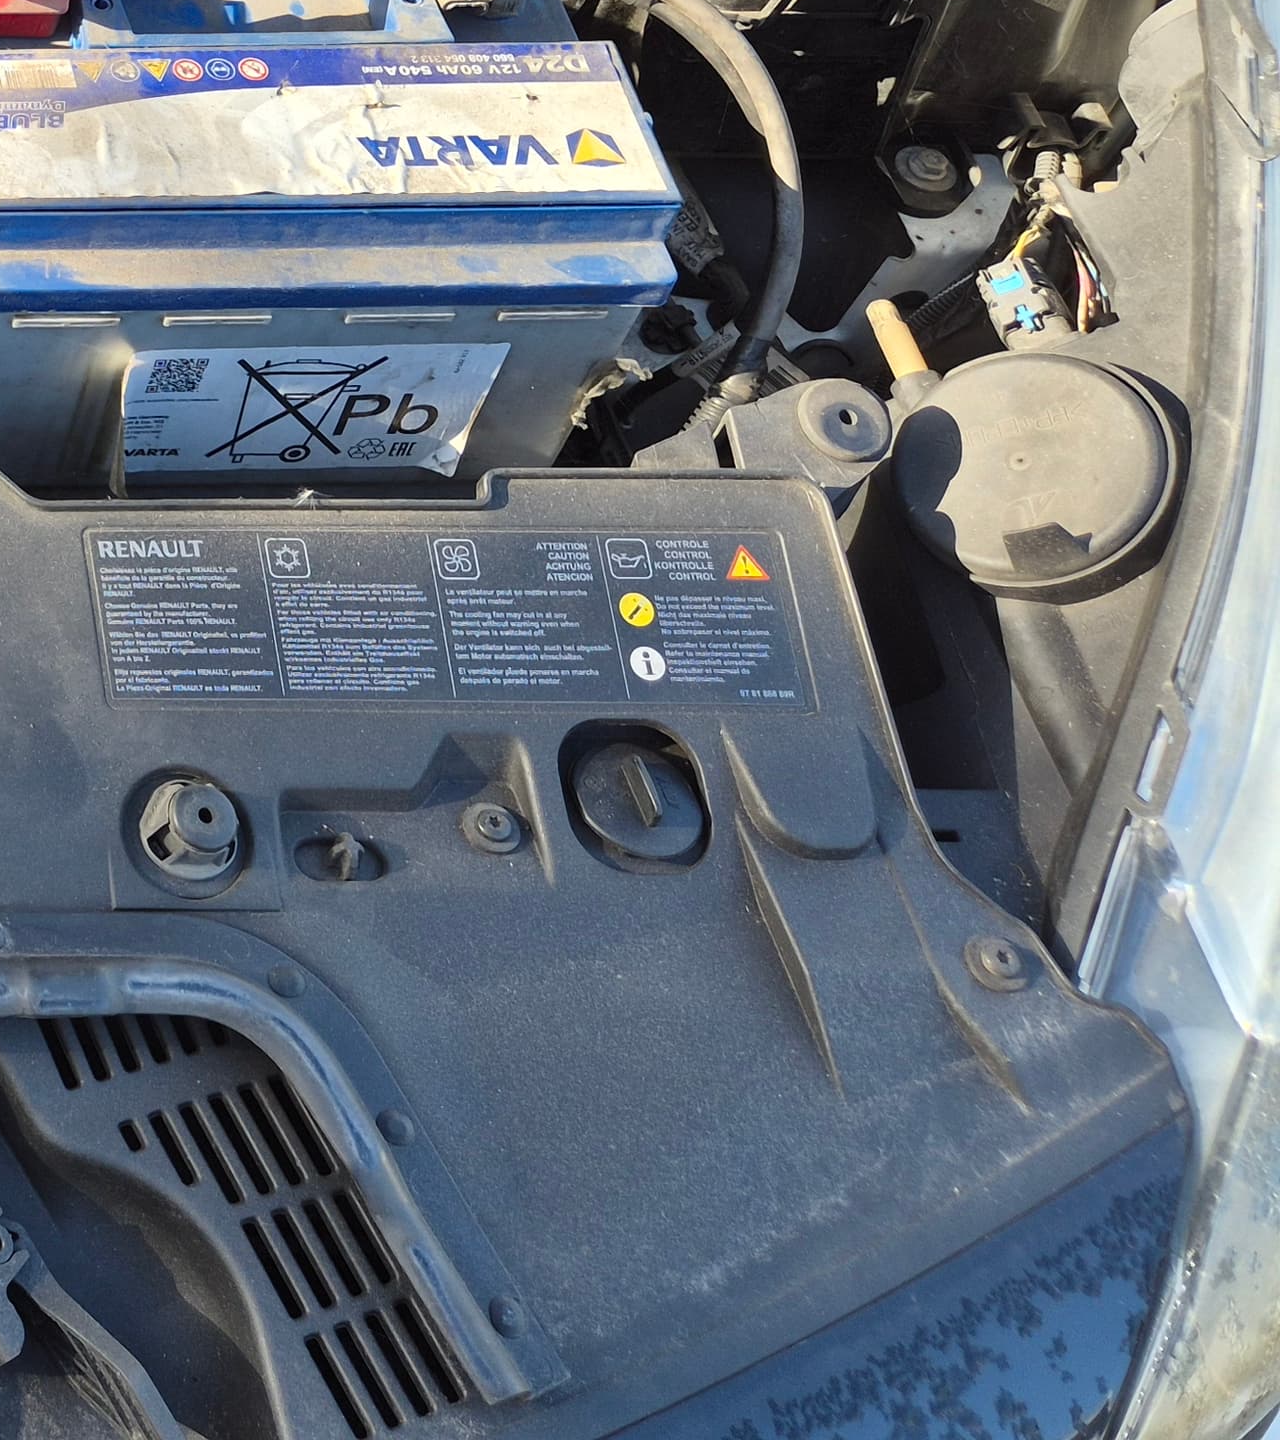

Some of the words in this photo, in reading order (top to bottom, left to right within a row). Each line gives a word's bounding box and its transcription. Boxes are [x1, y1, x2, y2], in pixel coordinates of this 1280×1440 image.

[490, 63, 521, 74] 12V
[523, 54, 590, 73] D24
[436, 64, 483, 75] 60Ah
[356, 134, 559, 168] VARTA
[333, 393, 438, 435] Pb
[124, 448, 179, 456] VARTA
[97, 540, 203, 558] RENAULT
[656, 540, 709, 548] CONTROLE
[548, 552, 589, 560] CAUTION
[664, 551, 712, 559] CONTROL
[547, 573, 593, 581] ATENCION
